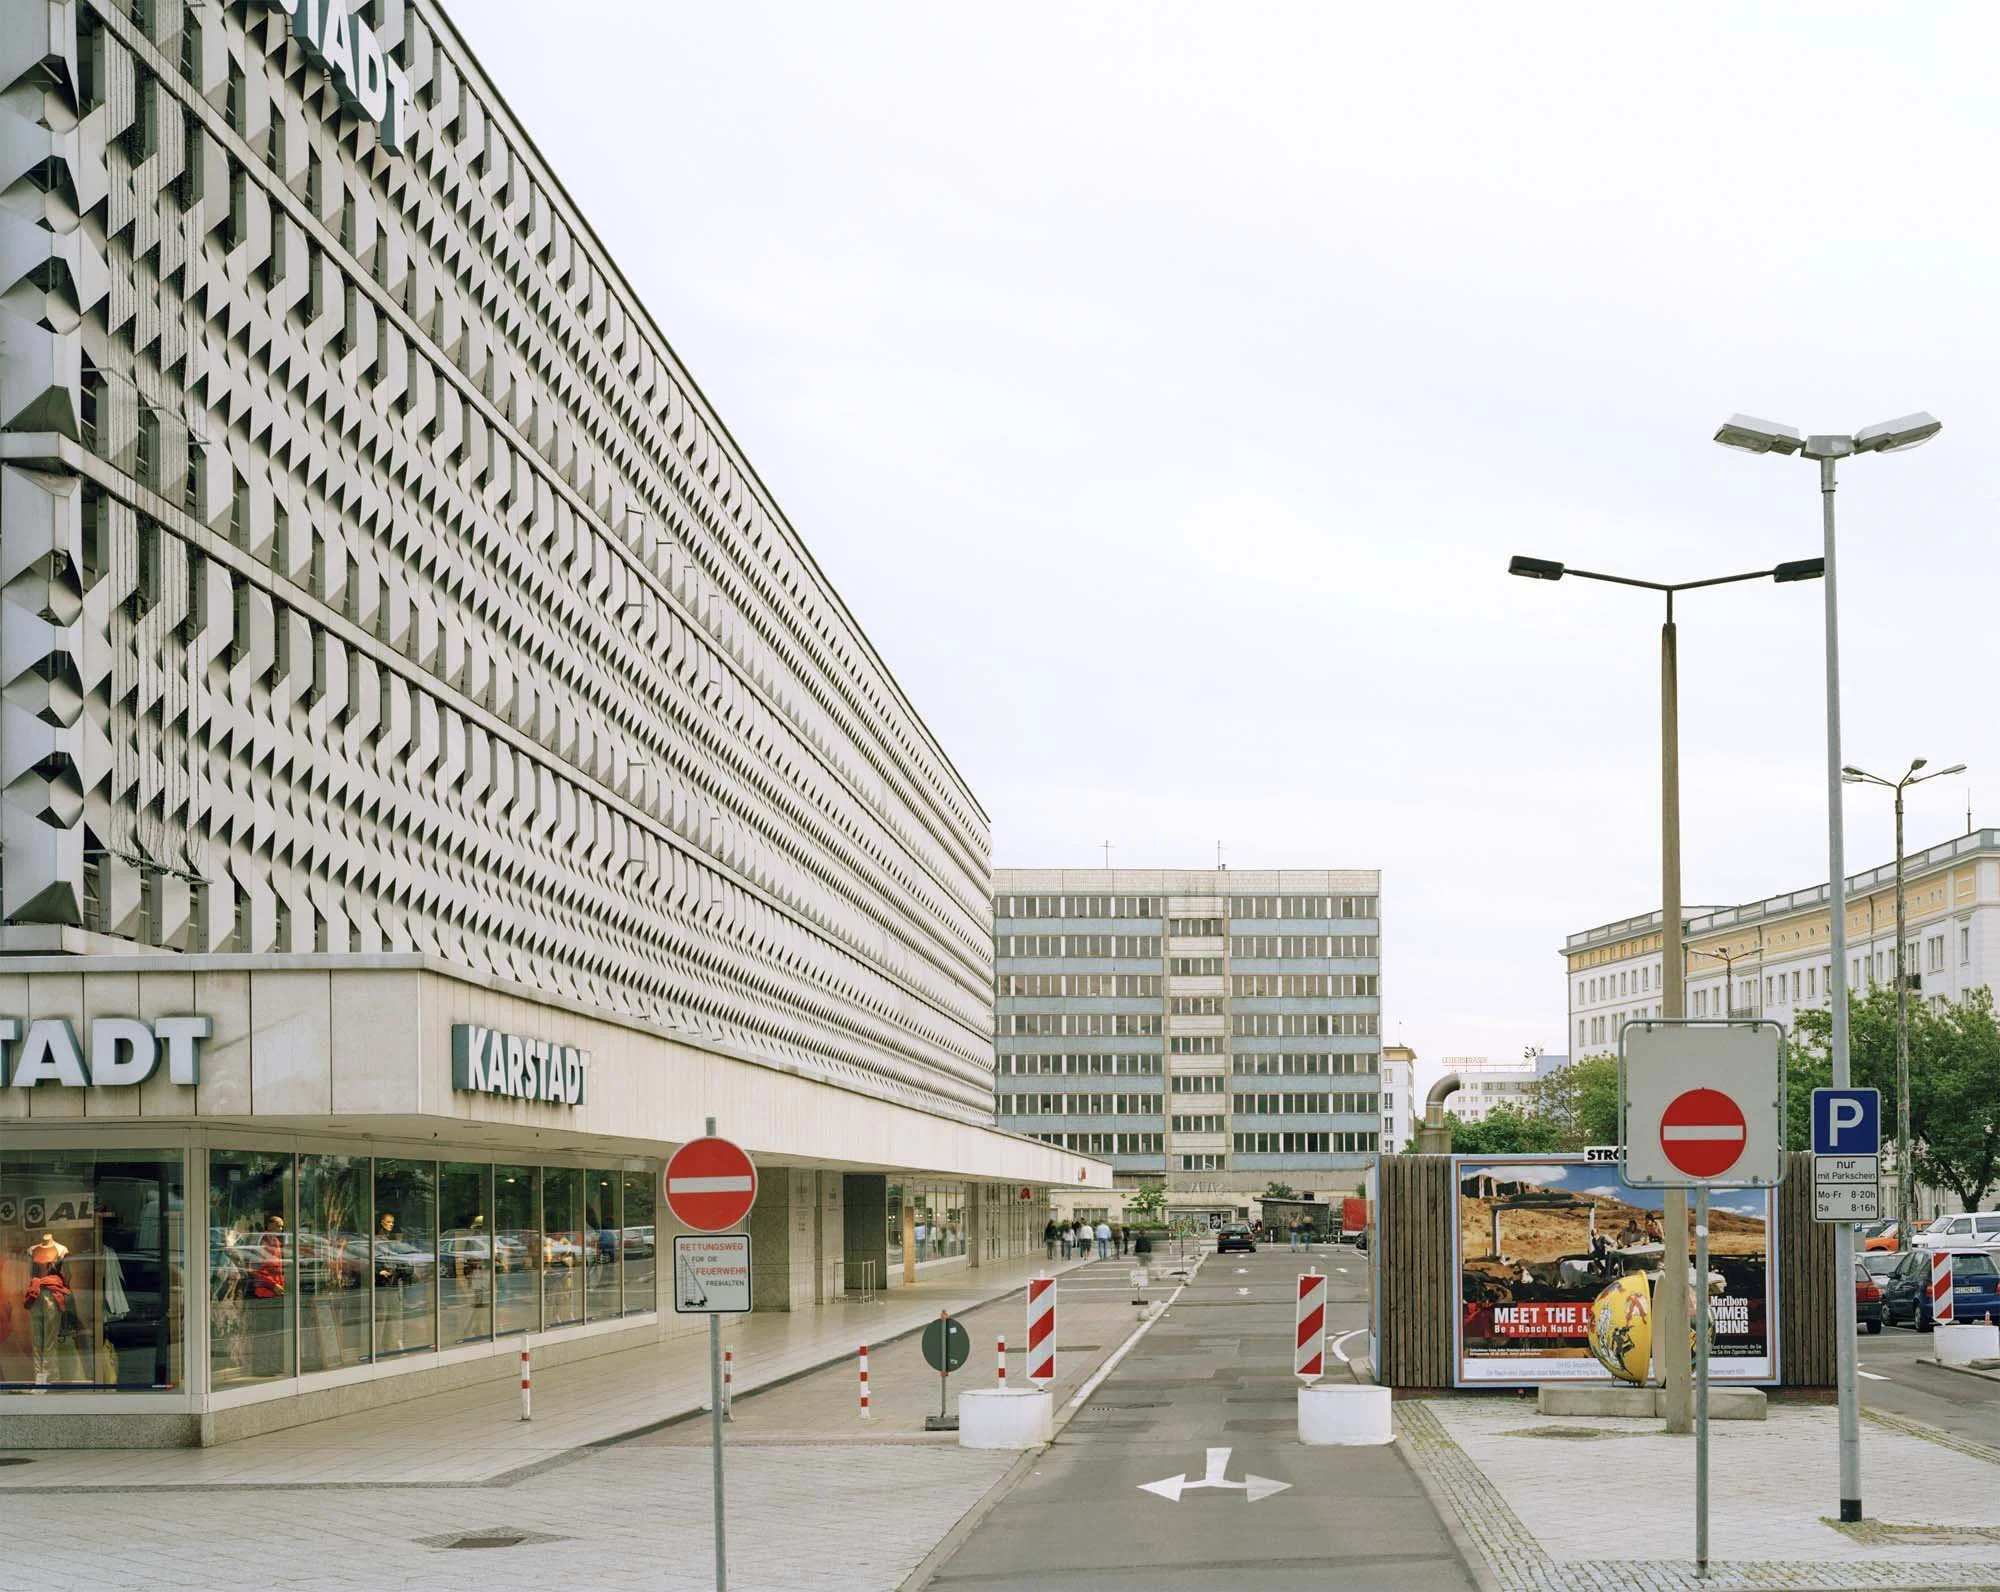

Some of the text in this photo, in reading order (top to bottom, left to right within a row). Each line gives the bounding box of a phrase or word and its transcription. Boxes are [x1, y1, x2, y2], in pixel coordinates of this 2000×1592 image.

[464, 1024, 591, 1105] KARSTADT
[1829, 1098, 1864, 1147] P
[1836, 1160, 1856, 1169] nur
[1817, 1171, 1876, 1180] mit Parkschein
[1850, 1190, 1876, 1199] 8-20h
[1818, 1203, 1876, 1212] Sa 8-16h
[680, 1242, 744, 1251] RETTUNGSWEG
[696, 1266, 747, 1275] FEUERWEHR
[1710, 1295, 1748, 1306] Marlboro
[1494, 1307, 1540, 1324] MEET
[1545, 1307, 1577, 1324] THE
[1494, 1324, 1589, 1333] Be a Ranch Hand CA
